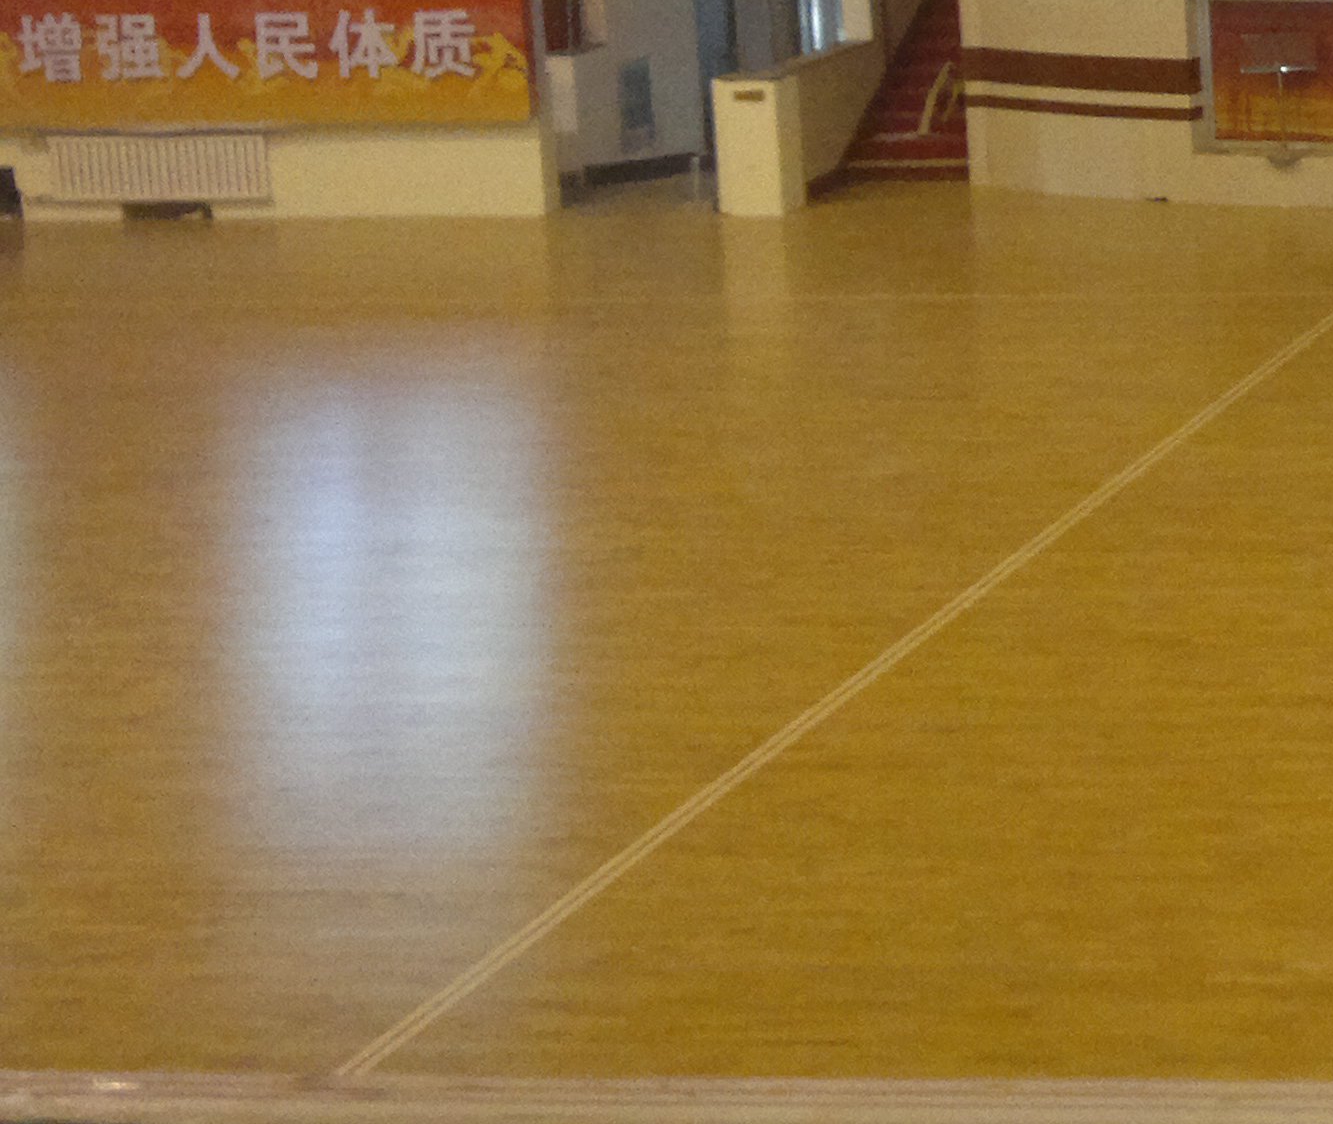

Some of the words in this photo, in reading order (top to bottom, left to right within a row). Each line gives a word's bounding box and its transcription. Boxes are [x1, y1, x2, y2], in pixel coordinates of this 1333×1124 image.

[18, 7, 478, 83] 增强人民体质
